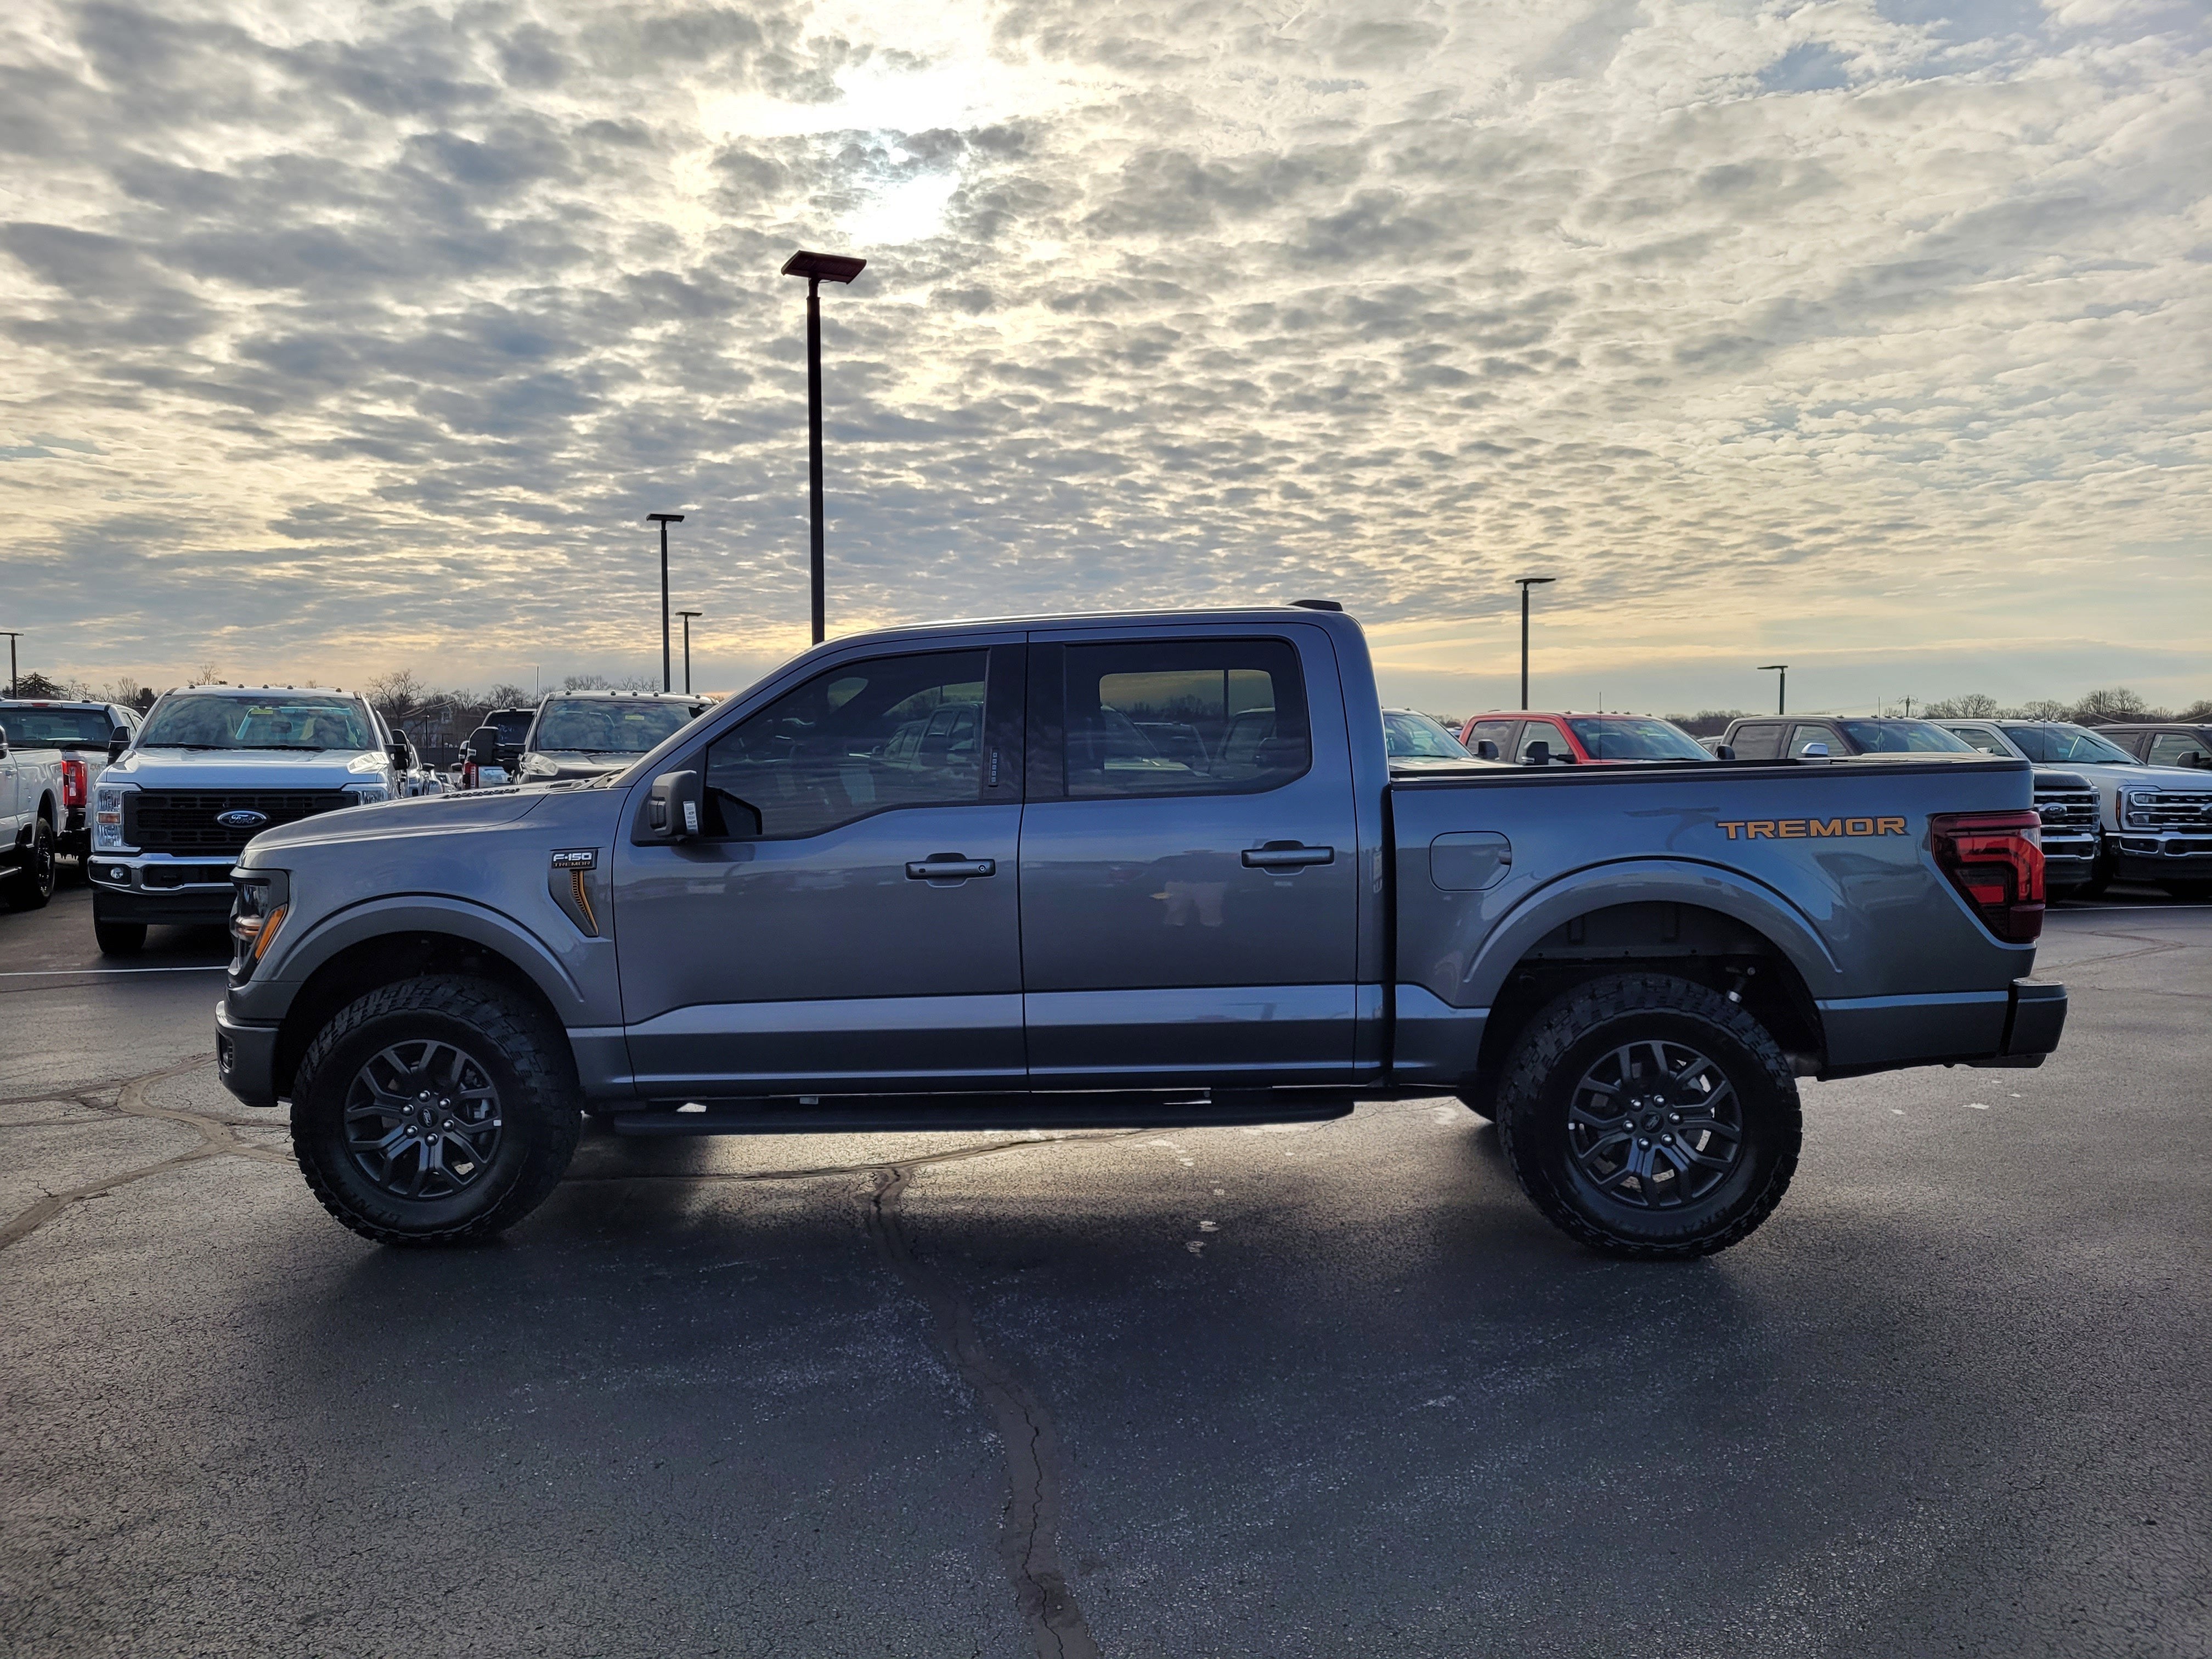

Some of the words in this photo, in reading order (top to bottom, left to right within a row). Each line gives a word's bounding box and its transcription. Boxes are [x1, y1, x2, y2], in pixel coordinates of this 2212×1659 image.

[229, 814, 255, 824] Ford
[1717, 817, 1906, 839] TREMOR
[553, 852, 592, 862] F-150
